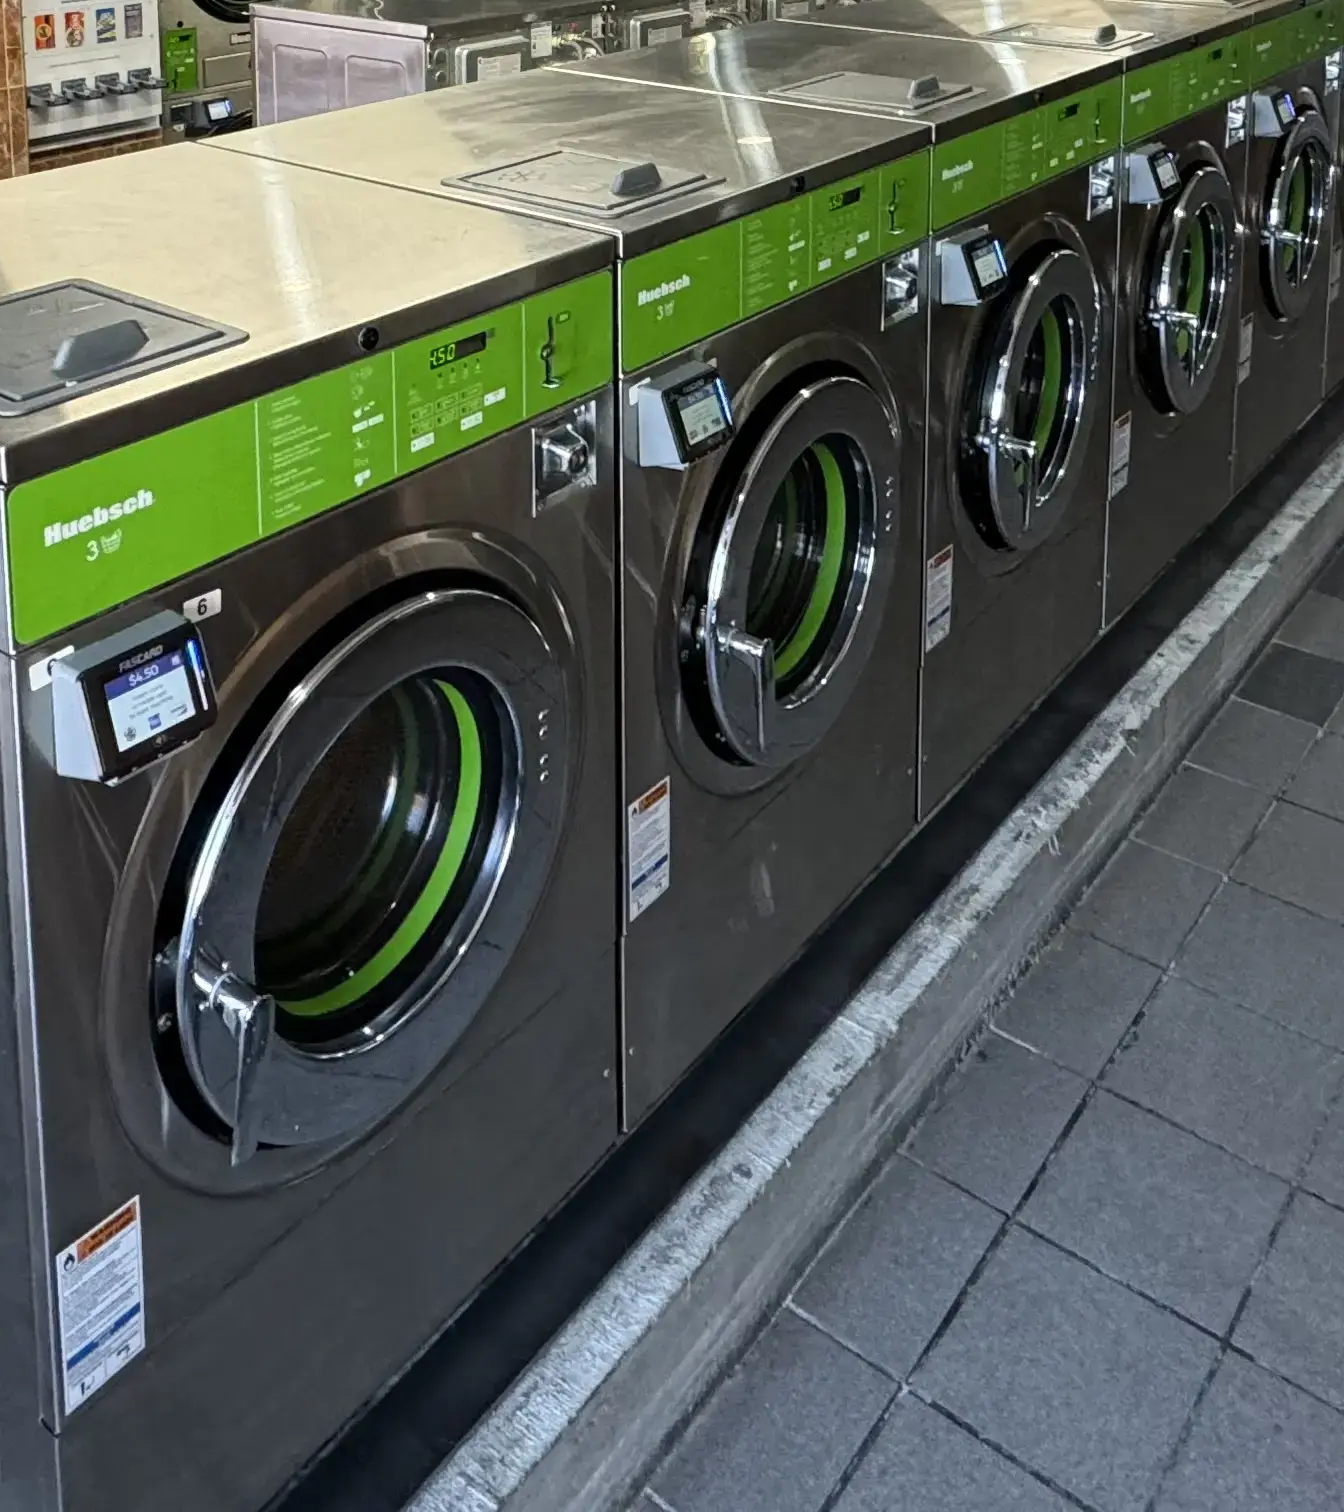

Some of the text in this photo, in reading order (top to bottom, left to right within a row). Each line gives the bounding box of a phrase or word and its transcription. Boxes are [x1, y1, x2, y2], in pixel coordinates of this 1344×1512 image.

[638, 274, 690, 307] Huebsch
[44, 489, 153, 547] Huebsch
[86, 540, 99, 561] 3
[197, 598, 208, 615] 6
[119, 645, 163, 672] FASCARD
[128, 665, 160, 686] $4.50
